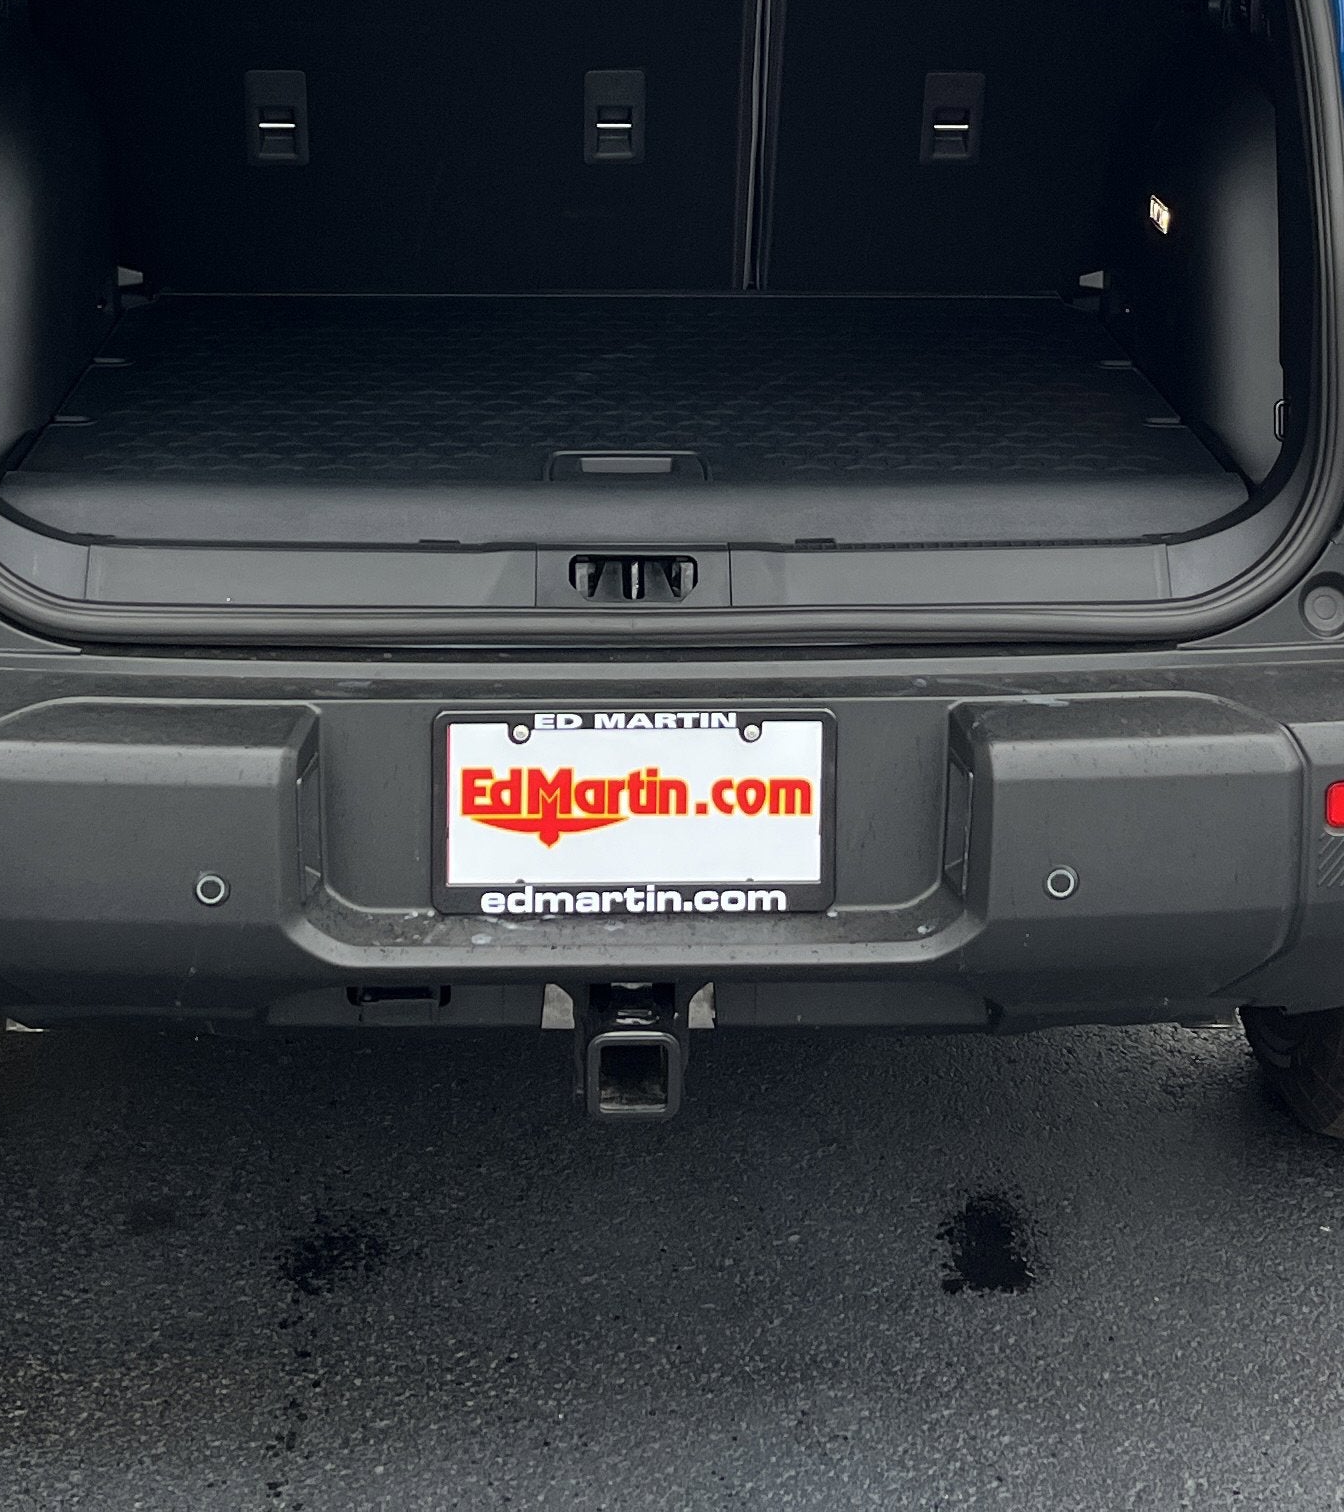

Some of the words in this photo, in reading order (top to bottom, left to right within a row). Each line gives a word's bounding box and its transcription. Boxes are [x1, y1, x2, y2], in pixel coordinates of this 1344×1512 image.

[534, 713, 583, 729] ED
[594, 712, 737, 729] MARTIN
[459, 766, 814, 819] EdMartin.com
[480, 885, 788, 914] edmartin.com
